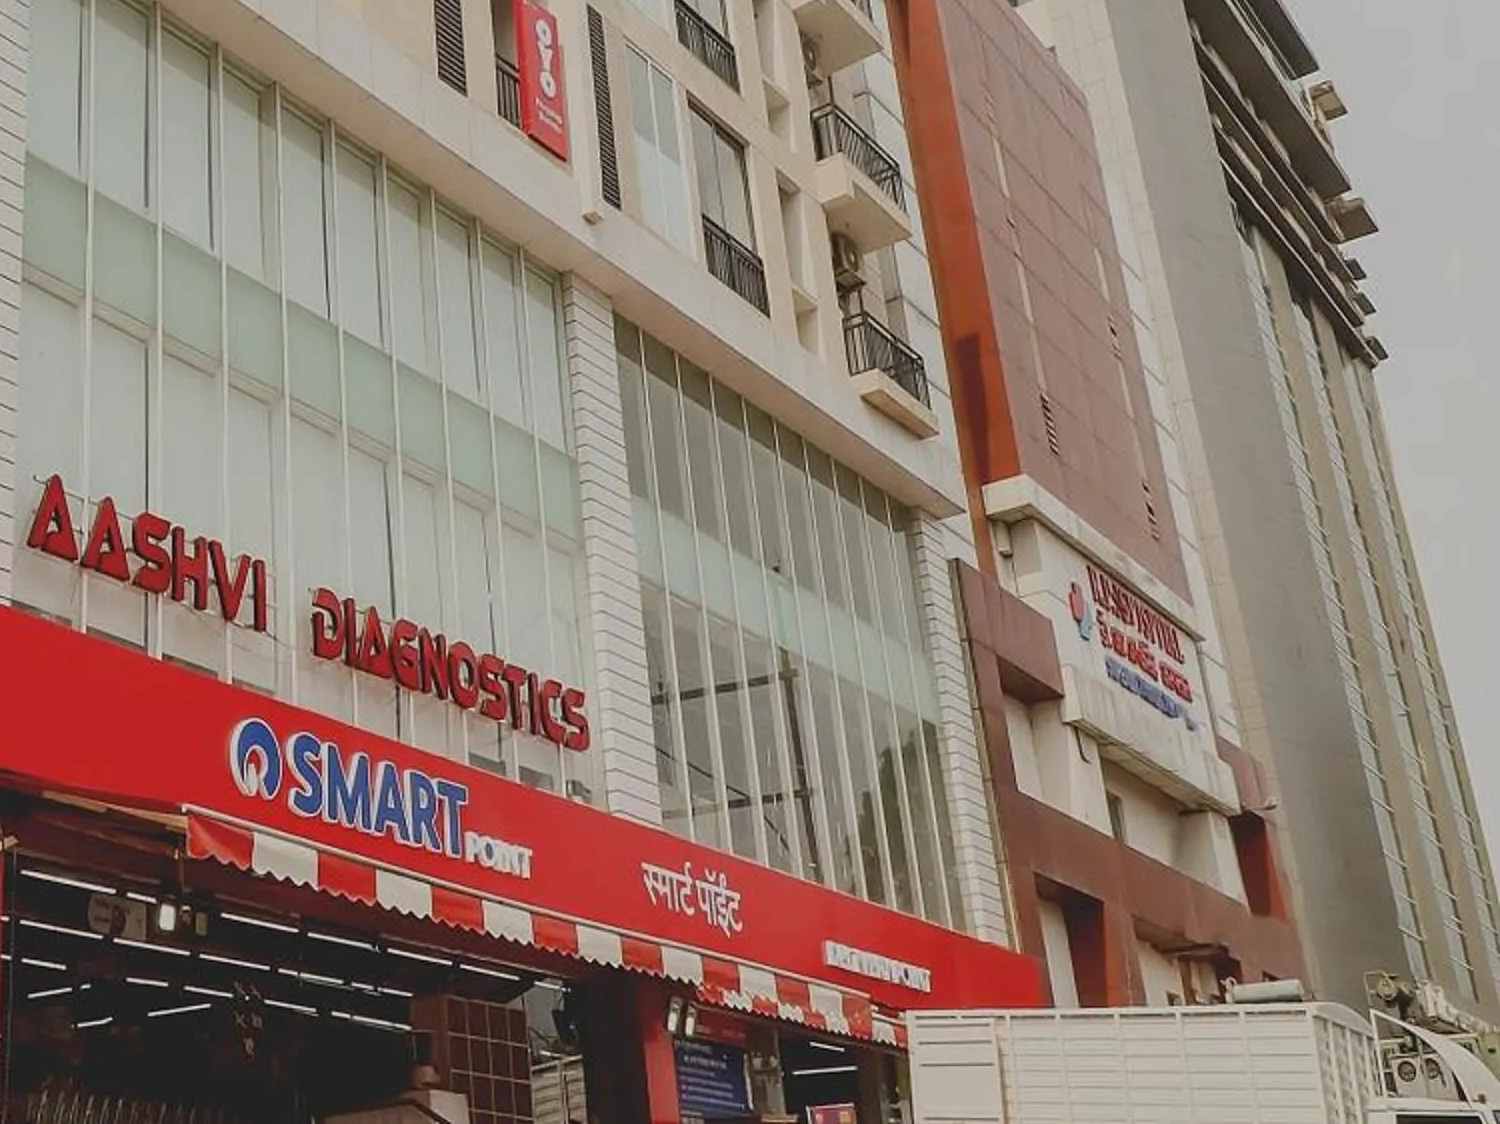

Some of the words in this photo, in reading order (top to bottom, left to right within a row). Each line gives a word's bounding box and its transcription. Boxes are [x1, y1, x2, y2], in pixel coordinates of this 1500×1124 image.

[535, 19, 557, 98] OYO
[26, 473, 268, 633] AASHVI
[310, 587, 591, 752] DIAGNOSTICS
[286, 732, 468, 859] SMART
[465, 831, 533, 879] POINT
[641, 861, 695, 916] स्मार्ट
